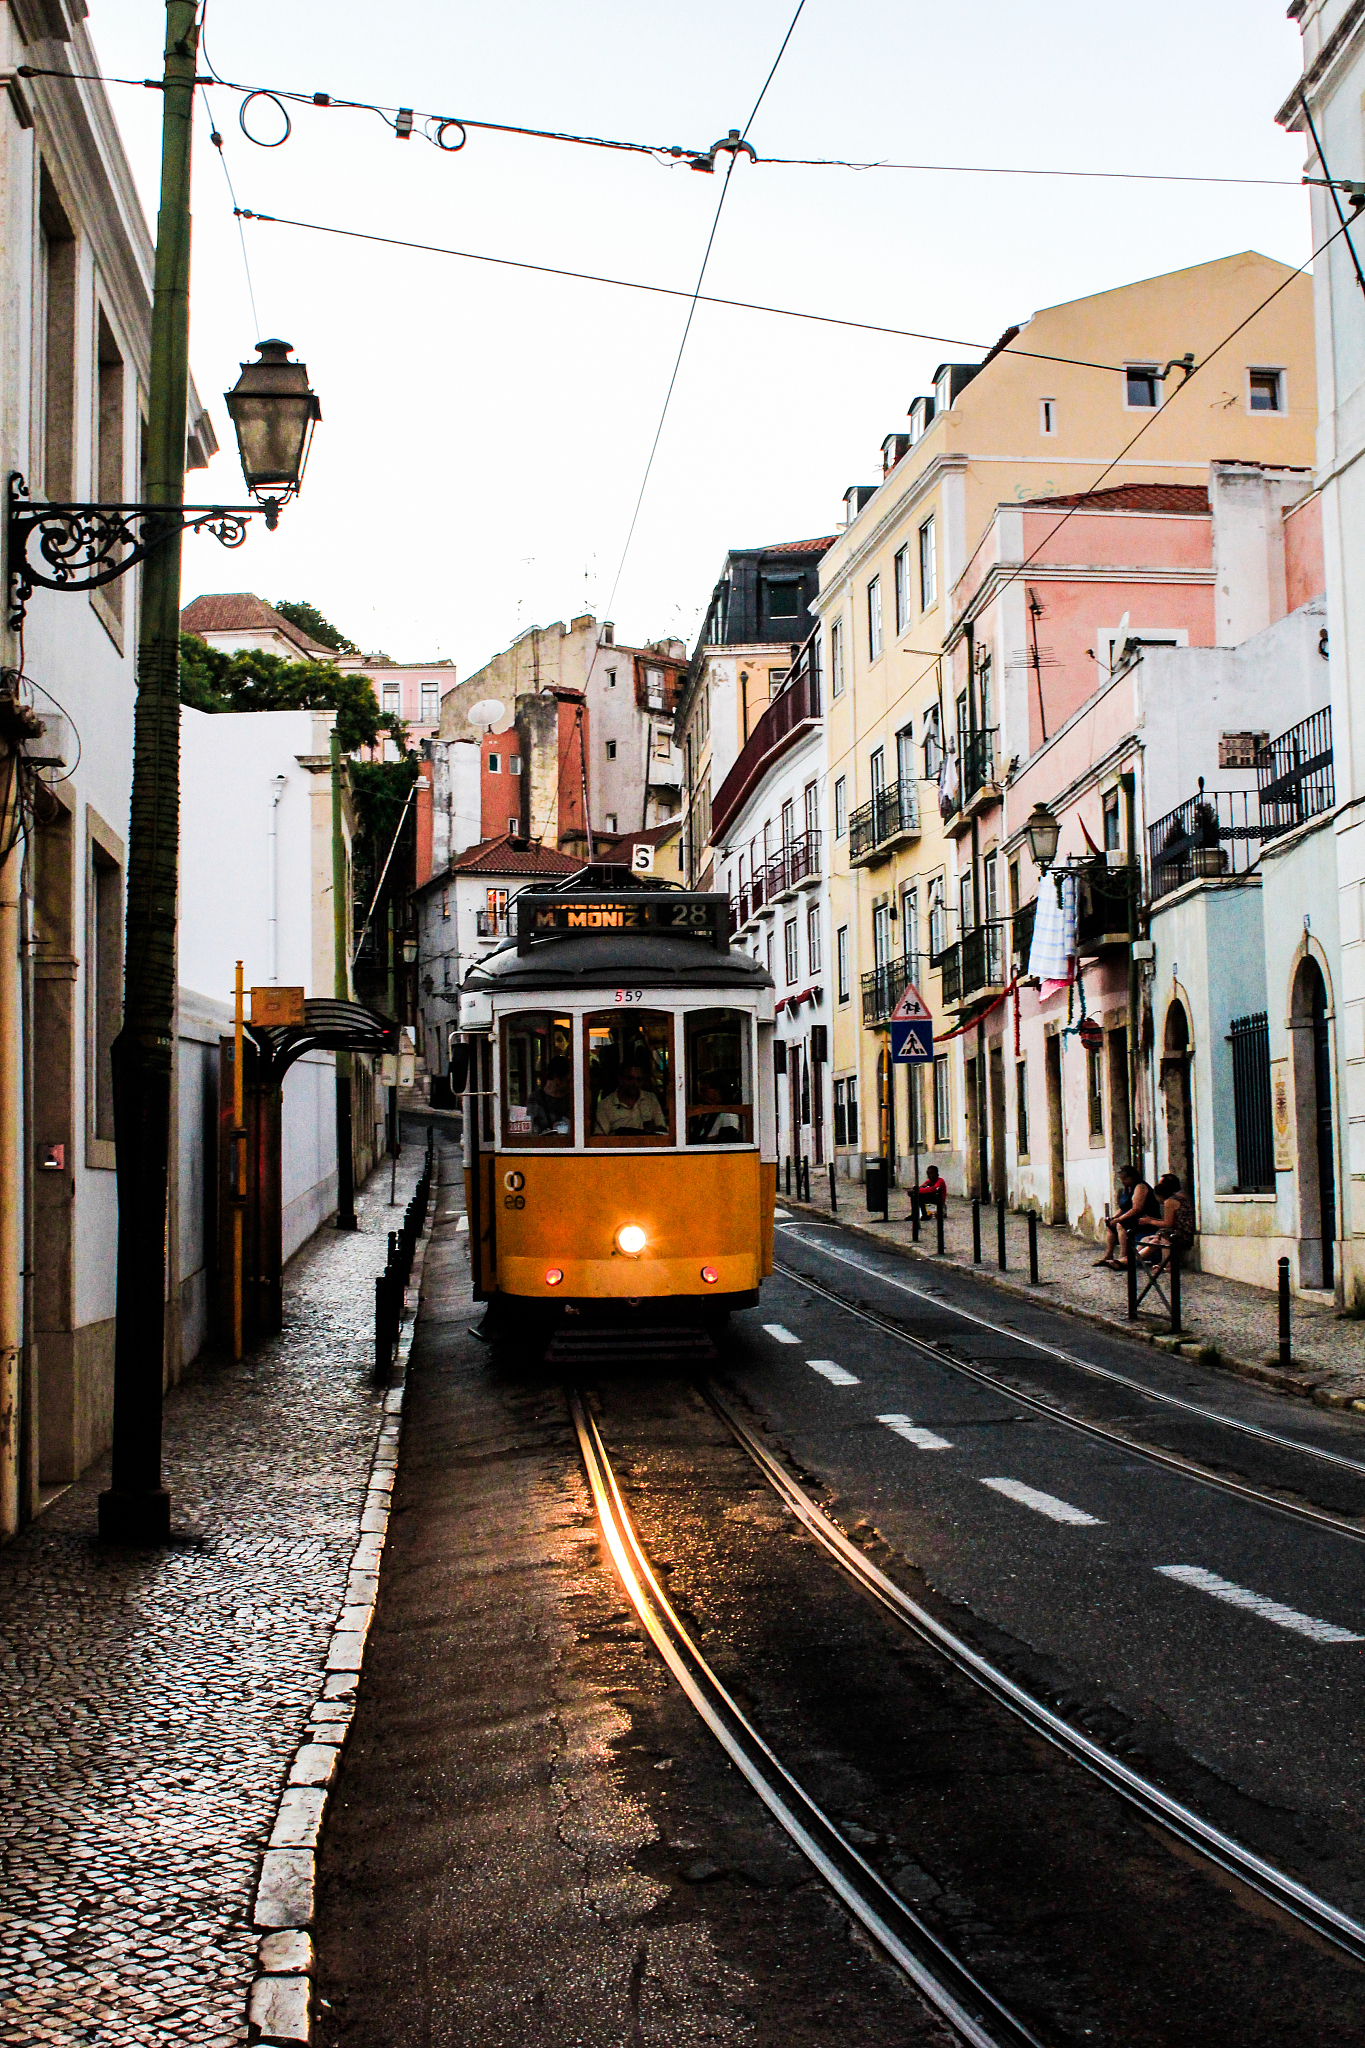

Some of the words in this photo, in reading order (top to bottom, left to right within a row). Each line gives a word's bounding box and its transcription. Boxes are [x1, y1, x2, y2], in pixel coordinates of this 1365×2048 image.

[635, 847, 650, 869] S
[567, 911, 639, 927] MONIZ
[671, 904, 707, 926] 28
[614, 990, 643, 1002] 559
